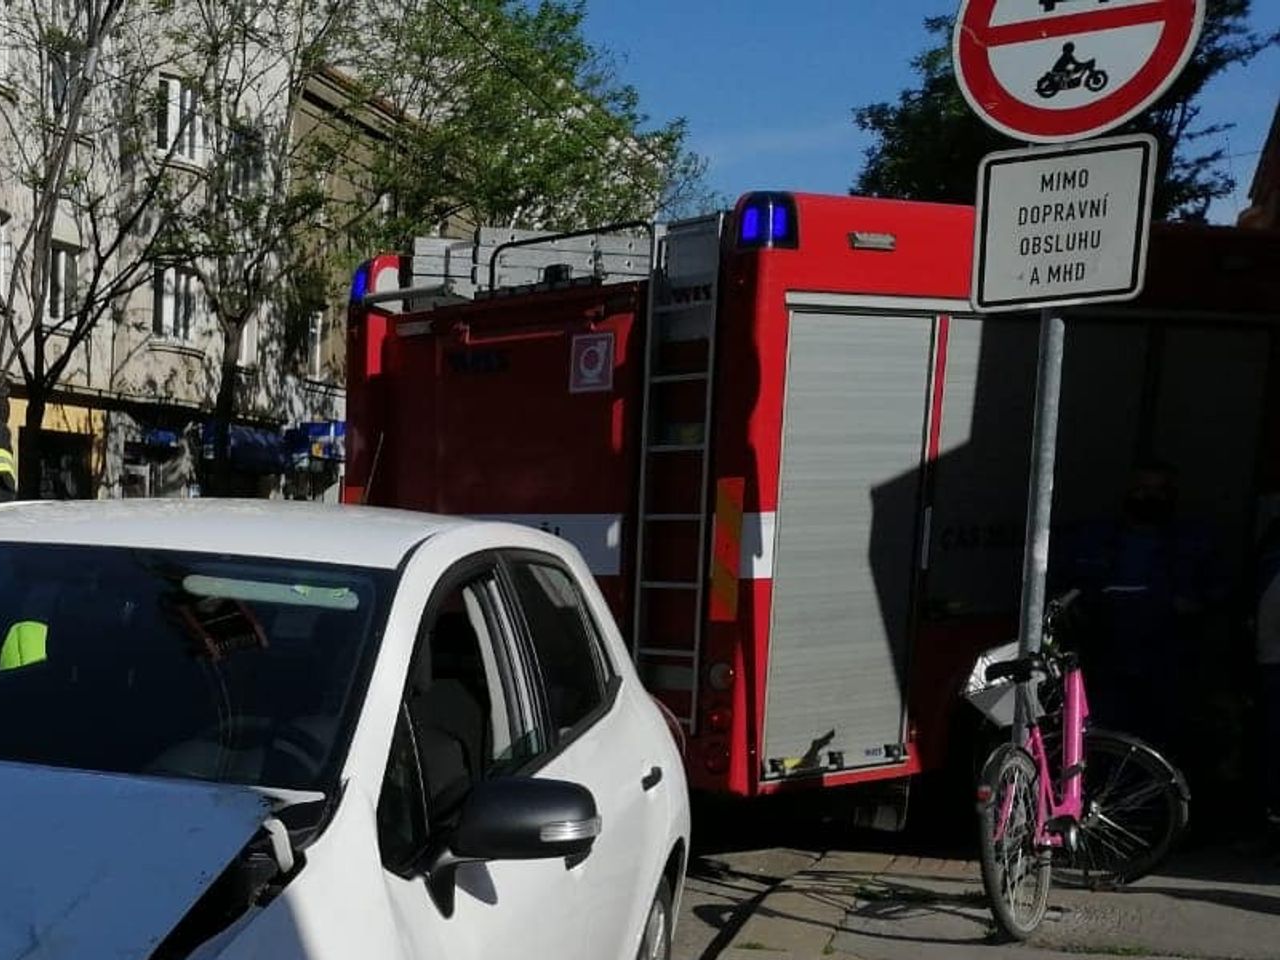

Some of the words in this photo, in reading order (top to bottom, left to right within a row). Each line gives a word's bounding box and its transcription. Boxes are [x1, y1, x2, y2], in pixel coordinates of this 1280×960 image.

[1039, 168, 1090, 193] MIMO
[1017, 194, 1110, 226] DOPRAVNÍ
[1019, 230, 1102, 256] OBSLUHU
[1029, 266, 1041, 286] A
[1047, 262, 1086, 284] MHD
